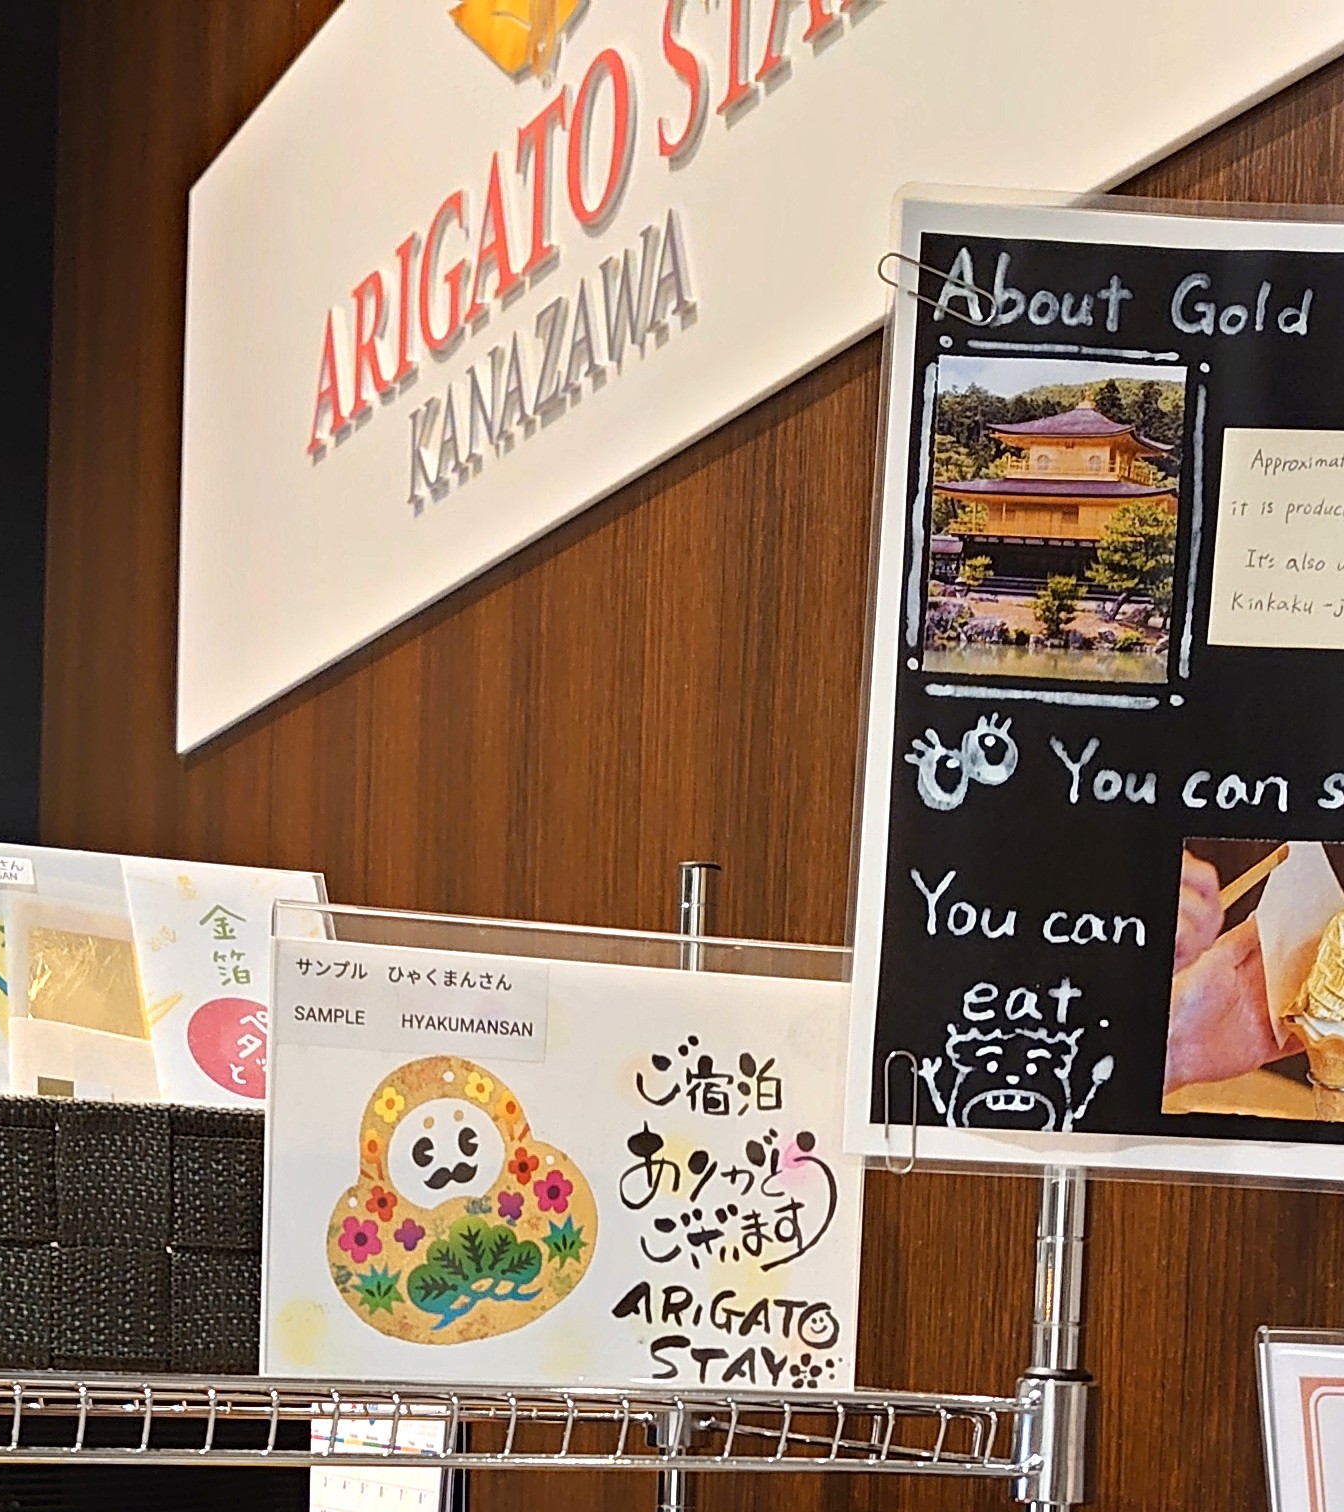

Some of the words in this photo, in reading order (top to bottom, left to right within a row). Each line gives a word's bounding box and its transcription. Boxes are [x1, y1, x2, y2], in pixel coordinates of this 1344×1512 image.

[306, 49, 631, 459] ARIGATO
[933, 247, 1132, 331] About
[1172, 273, 1312, 336] Gold
[408, 208, 695, 509] KANAZAWA
[1231, 501, 1248, 516] it
[1261, 501, 1273, 514] is
[1245, 549, 1274, 569] It's
[1286, 552, 1326, 572] also
[1050, 736, 1157, 804] You
[1182, 769, 1288, 812] can
[198, 904, 251, 986] 金箔
[910, 869, 1015, 937] You
[1043, 907, 1146, 946] can
[295, 957, 369, 980] サンプル
[387, 965, 513, 992] ひゃくまんさん
[962, 978, 1111, 1029] eat.
[294, 1006, 365, 1027] SAMPLE
[401, 1013, 534, 1038] HYAKUMANSAN
[637, 1035, 783, 1120] ご宿泊
[650, 1336, 789, 1387] STAY
